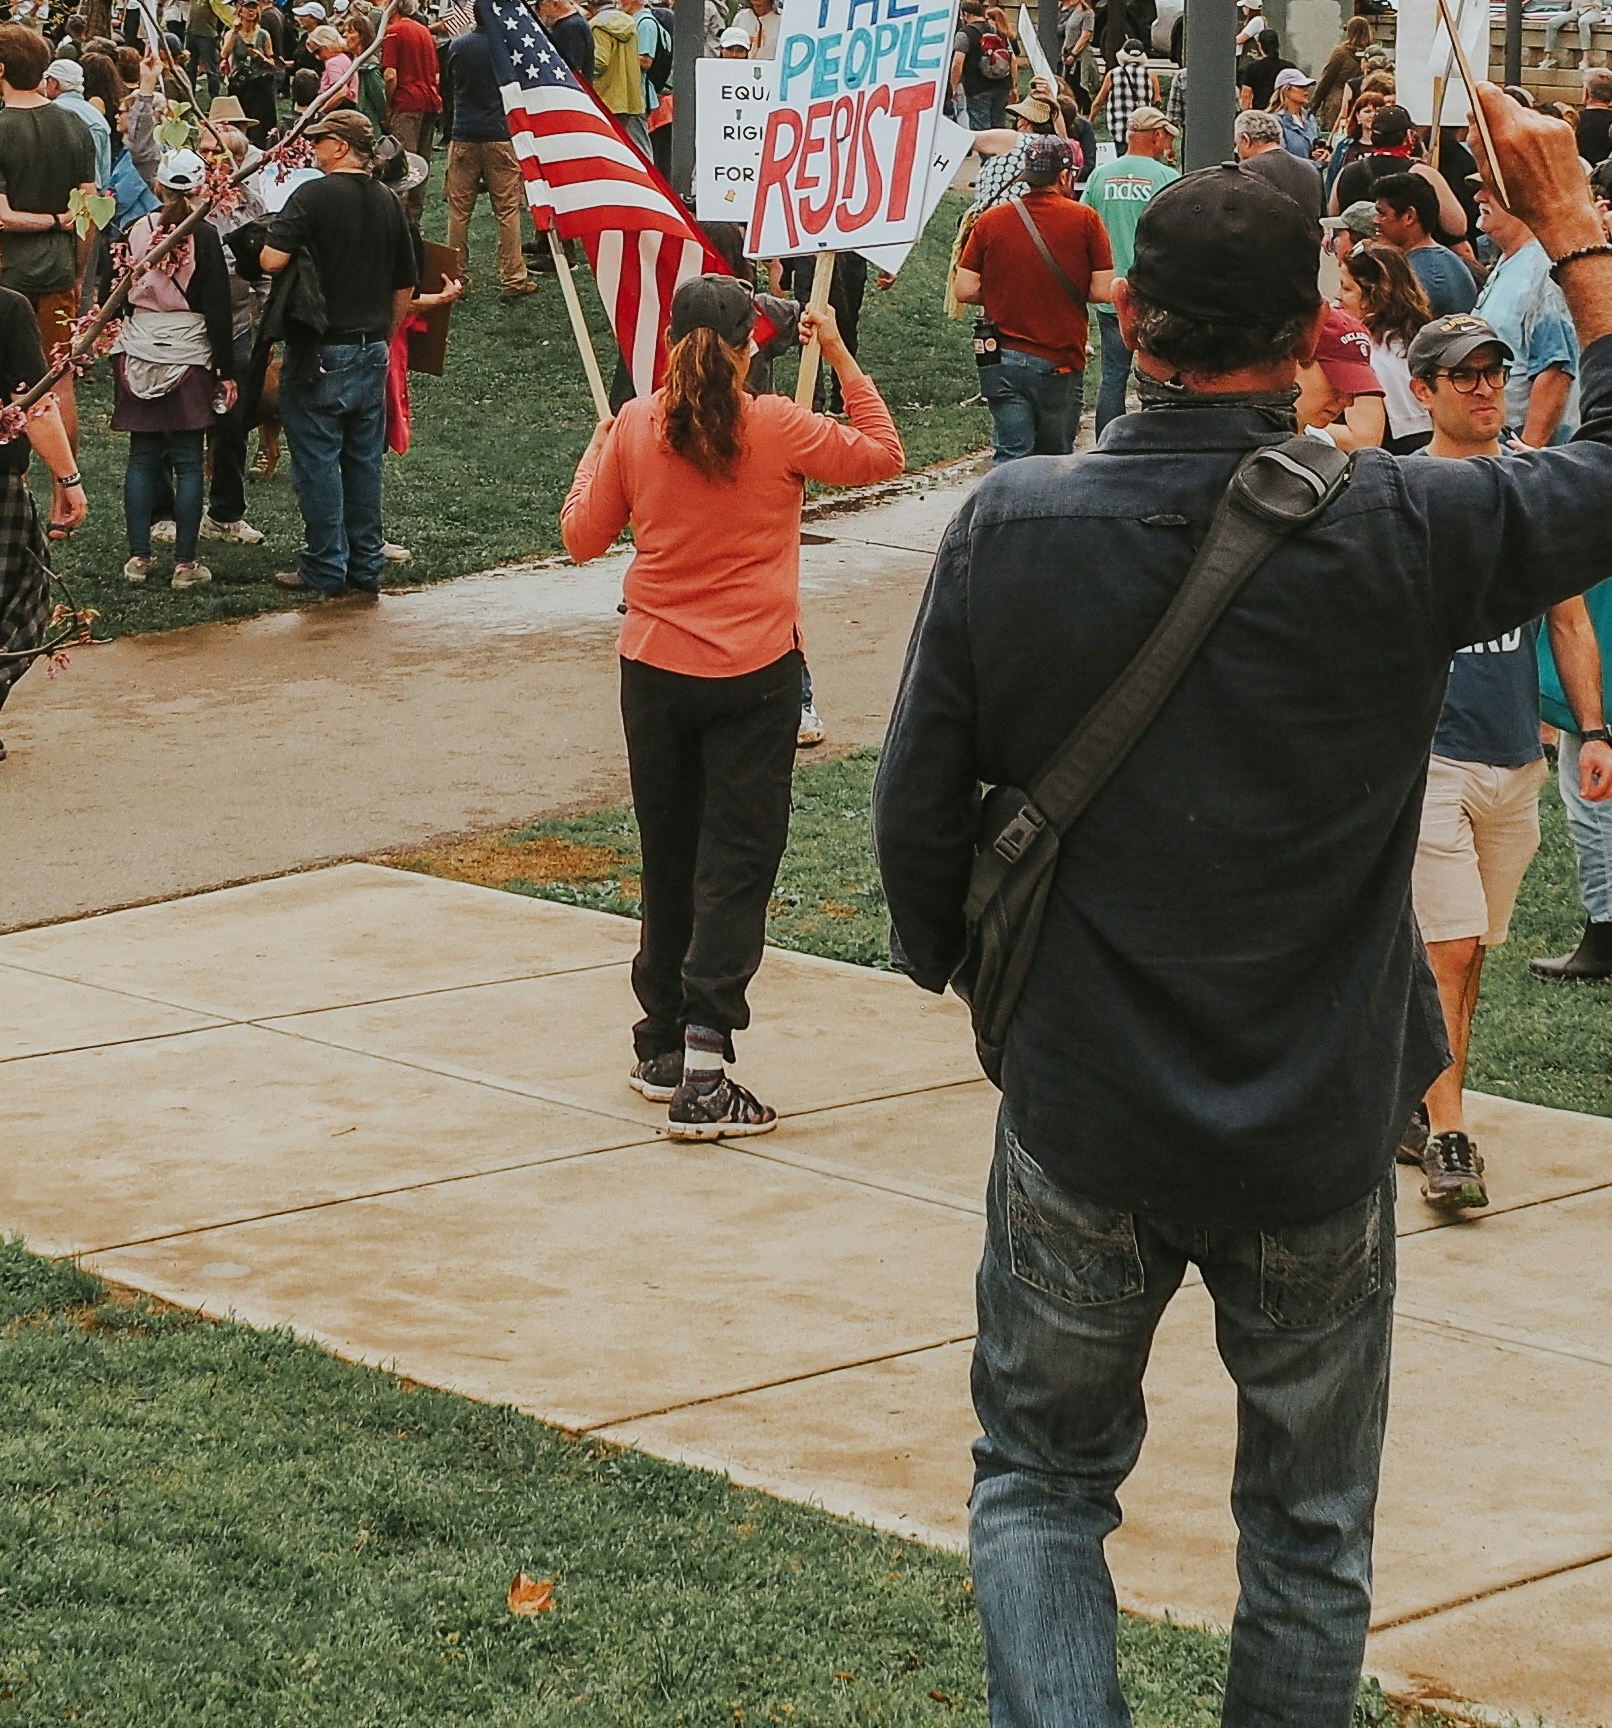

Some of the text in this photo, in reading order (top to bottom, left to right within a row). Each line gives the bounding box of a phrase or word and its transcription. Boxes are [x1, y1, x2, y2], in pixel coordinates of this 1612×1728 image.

[780, 9, 950, 102] PEOPLE
[714, 166, 754, 182] FOR
[749, 81, 936, 254] RESIST
